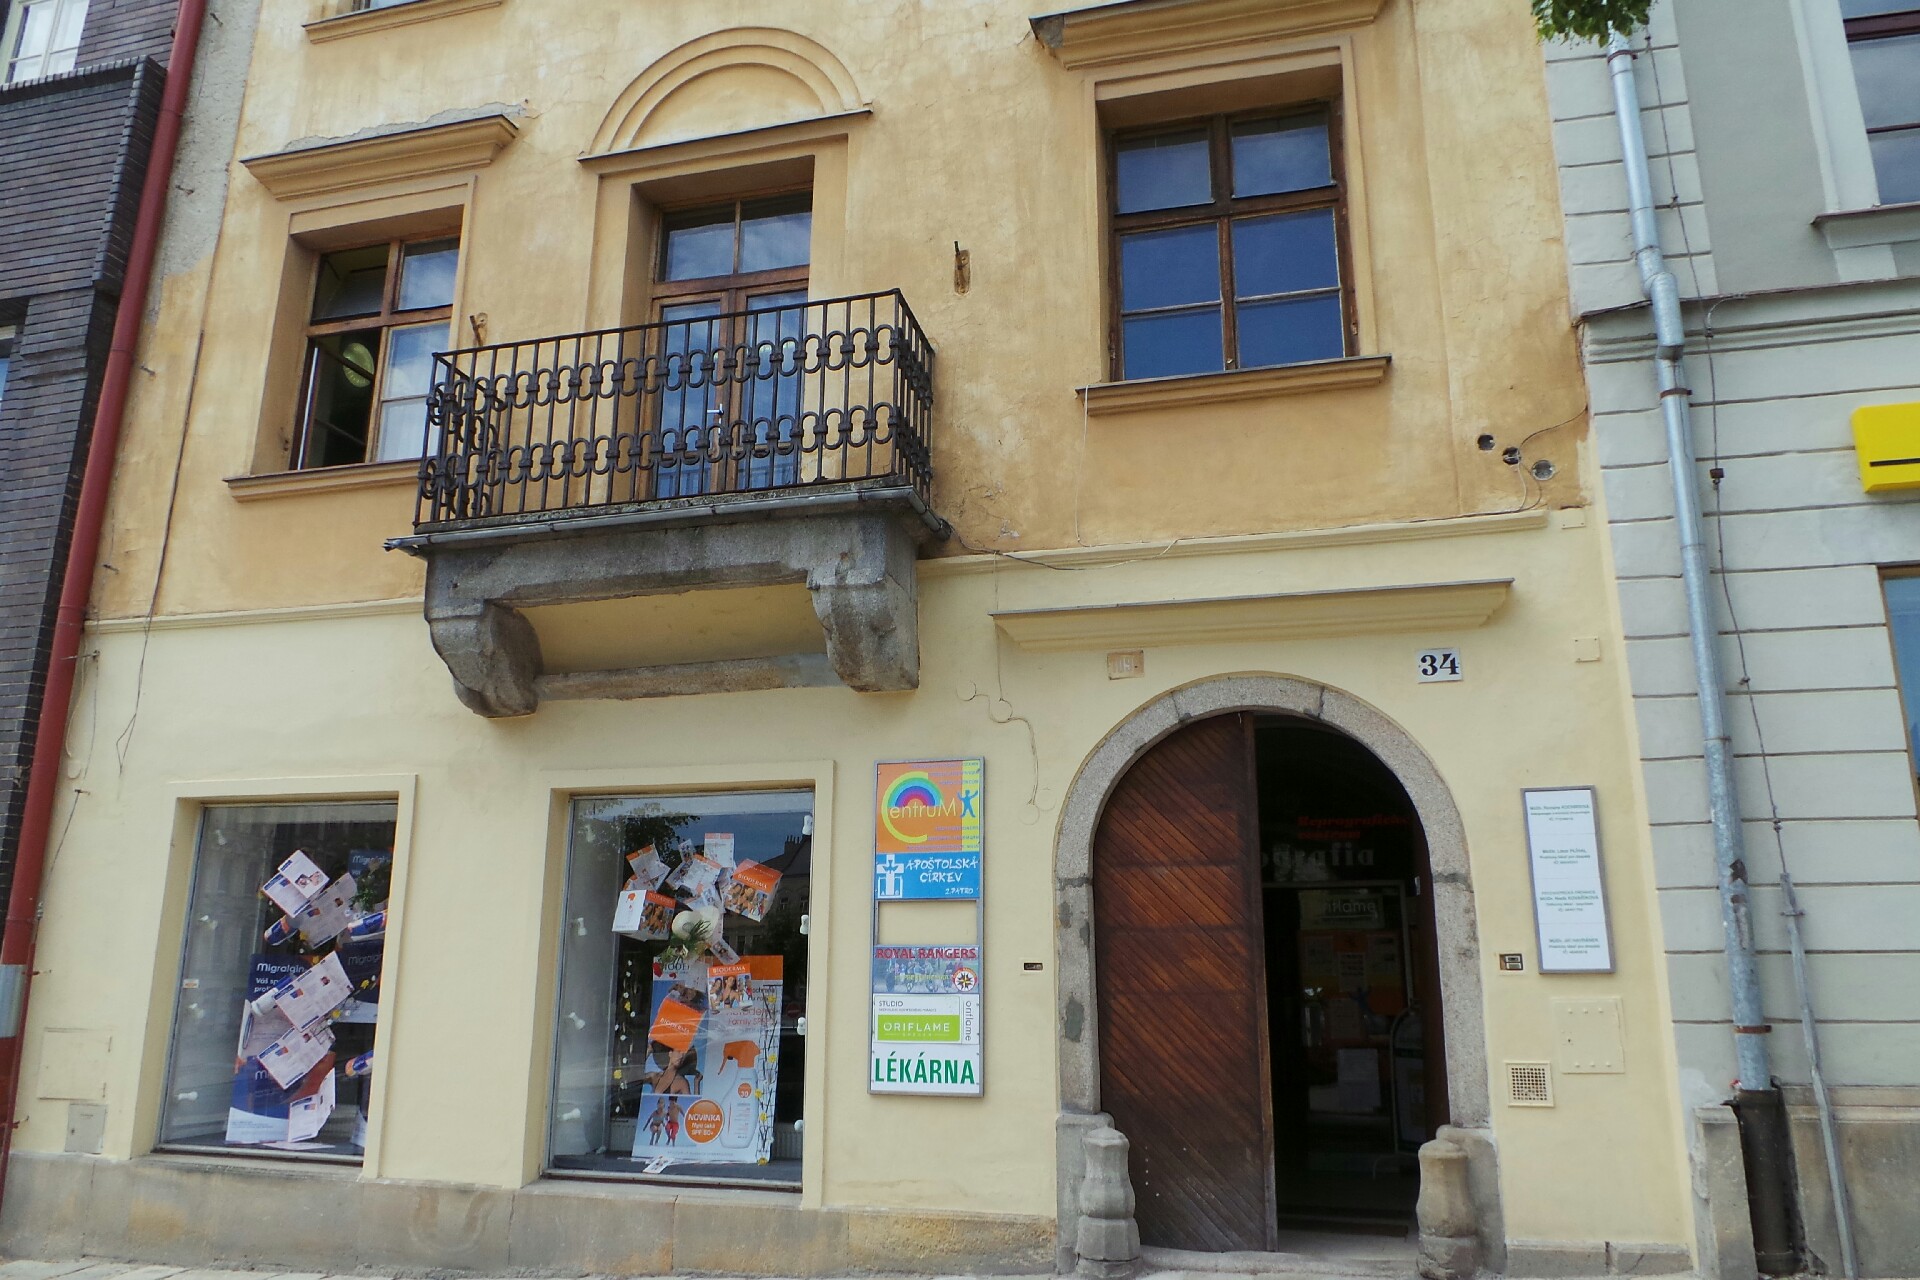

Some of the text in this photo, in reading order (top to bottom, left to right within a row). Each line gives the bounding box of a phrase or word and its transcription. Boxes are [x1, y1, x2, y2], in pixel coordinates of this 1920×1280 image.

[1420, 653, 1460, 676] 34
[905, 856, 978, 870] APOŠTOLSKÁ
[737, 872, 768, 889] BIODERMA
[919, 870, 963, 883] CÍRKEV
[875, 948, 977, 958] ROYAL RANGERS
[256, 963, 305, 974] Migralgin
[712, 965, 746, 975] BIODERMA
[883, 1022, 950, 1032] ORIFLAME
[965, 1000, 974, 1041] oriflame
[875, 1051, 975, 1084] LÉKÁRNA
[688, 1113, 721, 1122] NOVINKA
